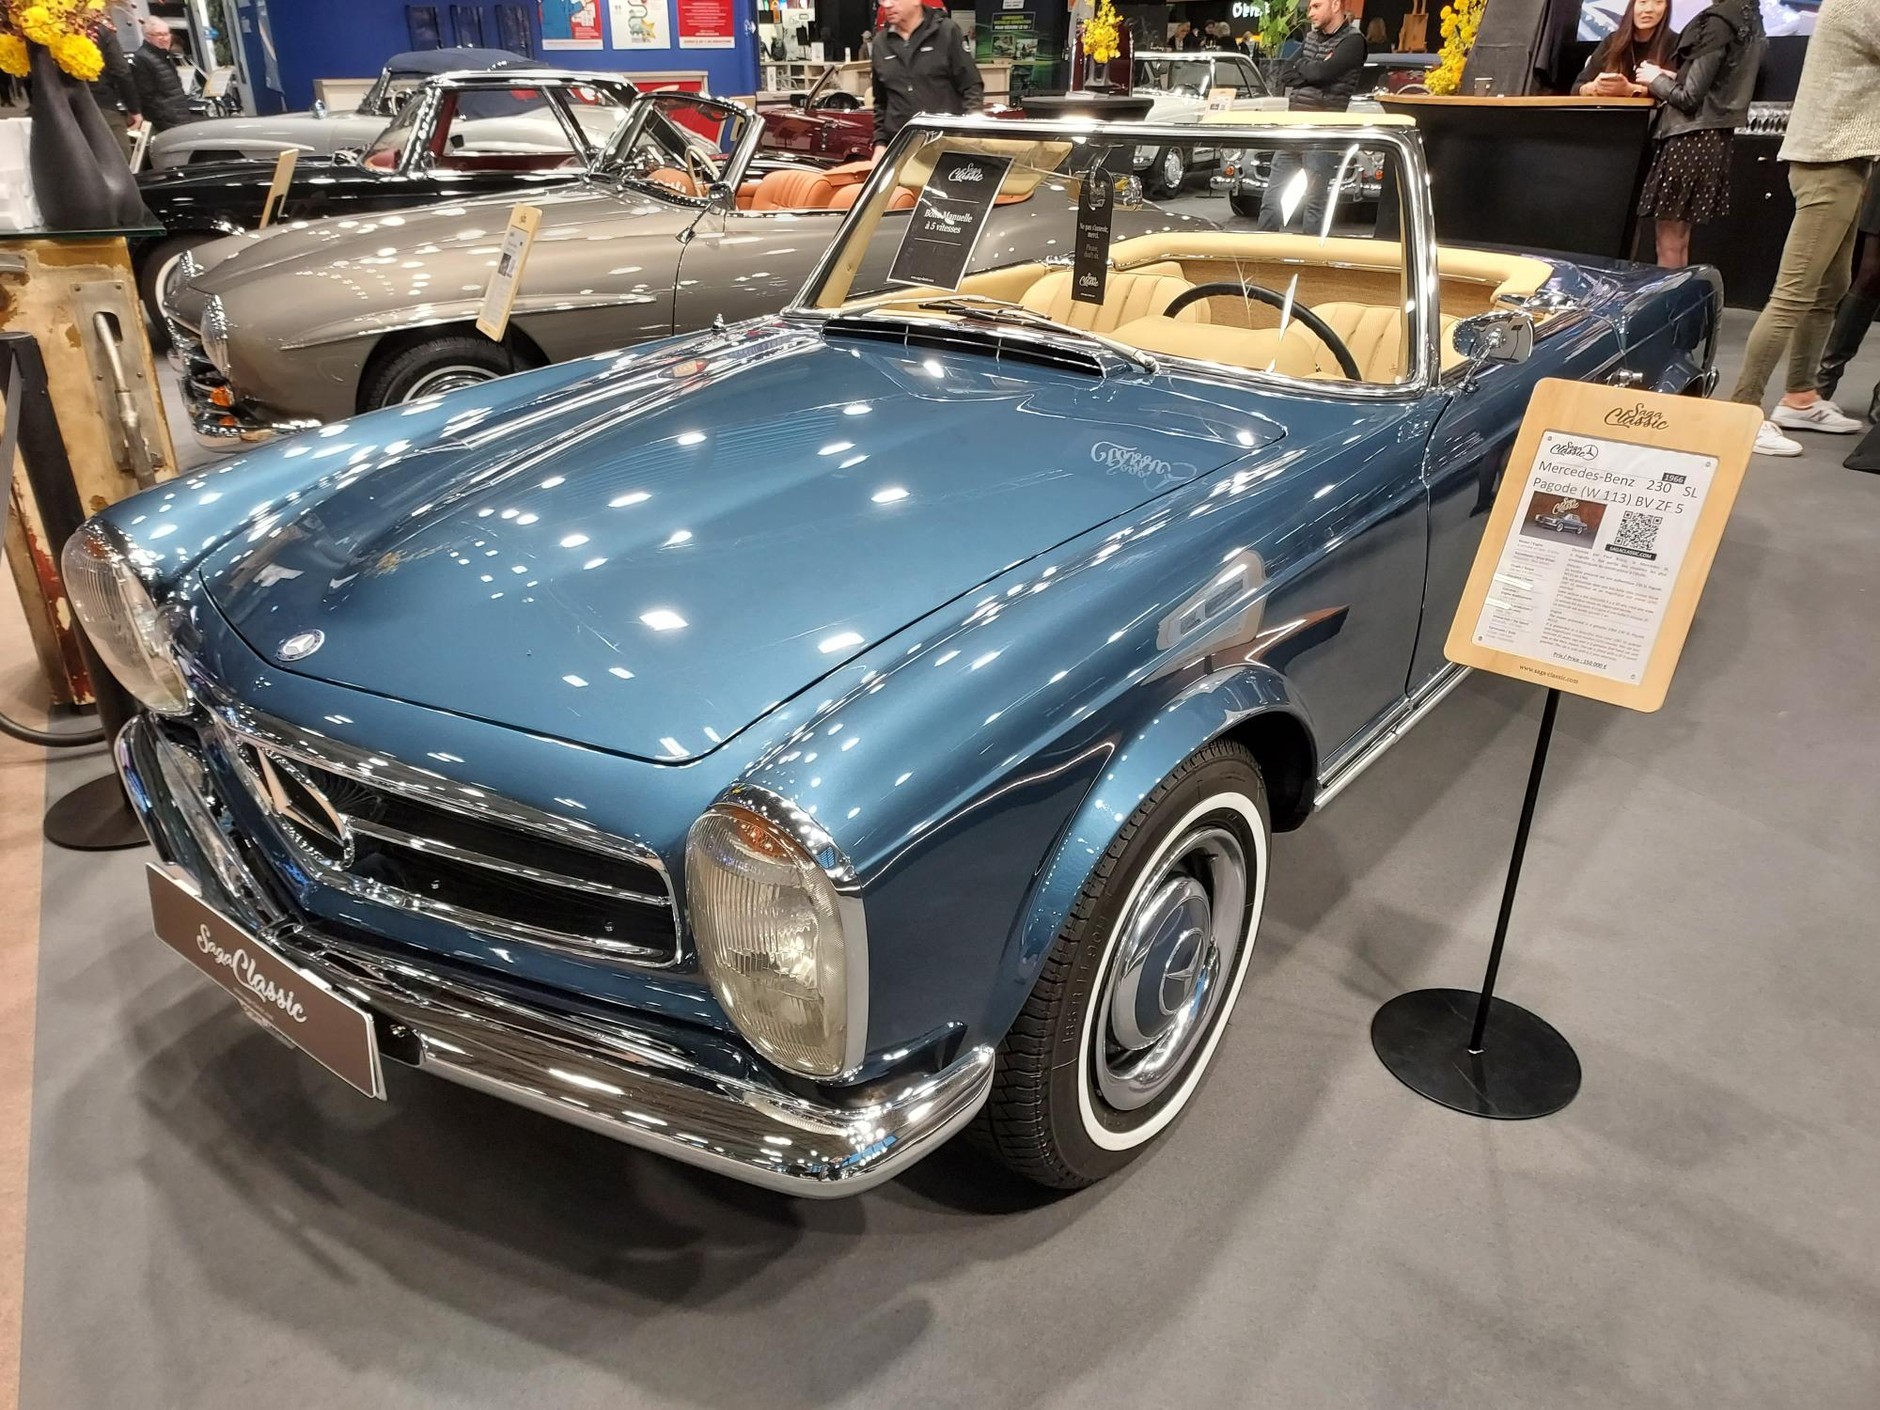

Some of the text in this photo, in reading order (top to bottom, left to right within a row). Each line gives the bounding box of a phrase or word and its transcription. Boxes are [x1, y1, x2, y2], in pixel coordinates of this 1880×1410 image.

[948, 168, 984, 182] Classic
[943, 211, 973, 223] Manuelle
[930, 222, 937, 230] 5
[937, 223, 962, 234] vitesses
[1630, 402, 1664, 419] Saga
[1604, 407, 1669, 430] Classic
[1550, 444, 1586, 457] Classic
[1538, 461, 1698, 499] Mercedes-Benz 230 SL
[1664, 474, 1684, 483] 1966
[1533, 477, 1684, 514] Pagode (W 113) BV ZF 5
[1609, 546, 1652, 558] SAGACLASSIC.COM
